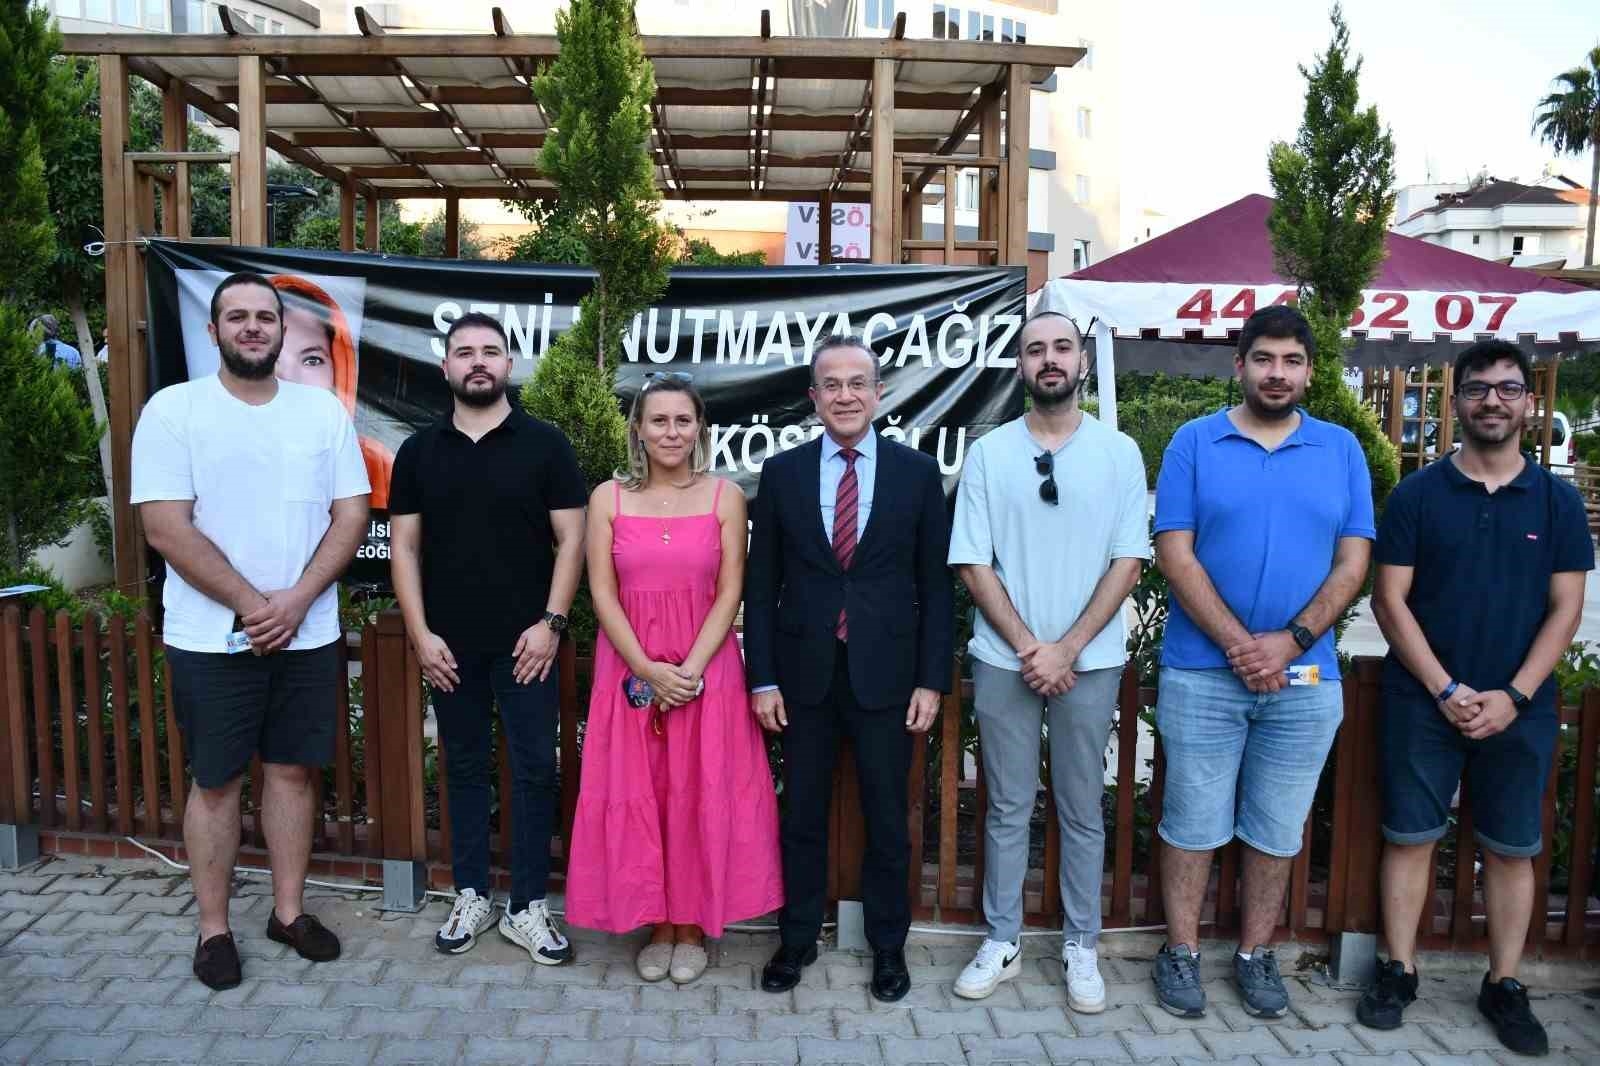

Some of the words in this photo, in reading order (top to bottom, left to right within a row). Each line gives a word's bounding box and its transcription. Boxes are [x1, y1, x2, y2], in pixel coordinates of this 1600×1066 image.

[430, 292, 553, 360] SNİ
[572, 300, 1022, 369] NUTMAYCAĞIZ
[1435, 294, 1518, 331] 07
